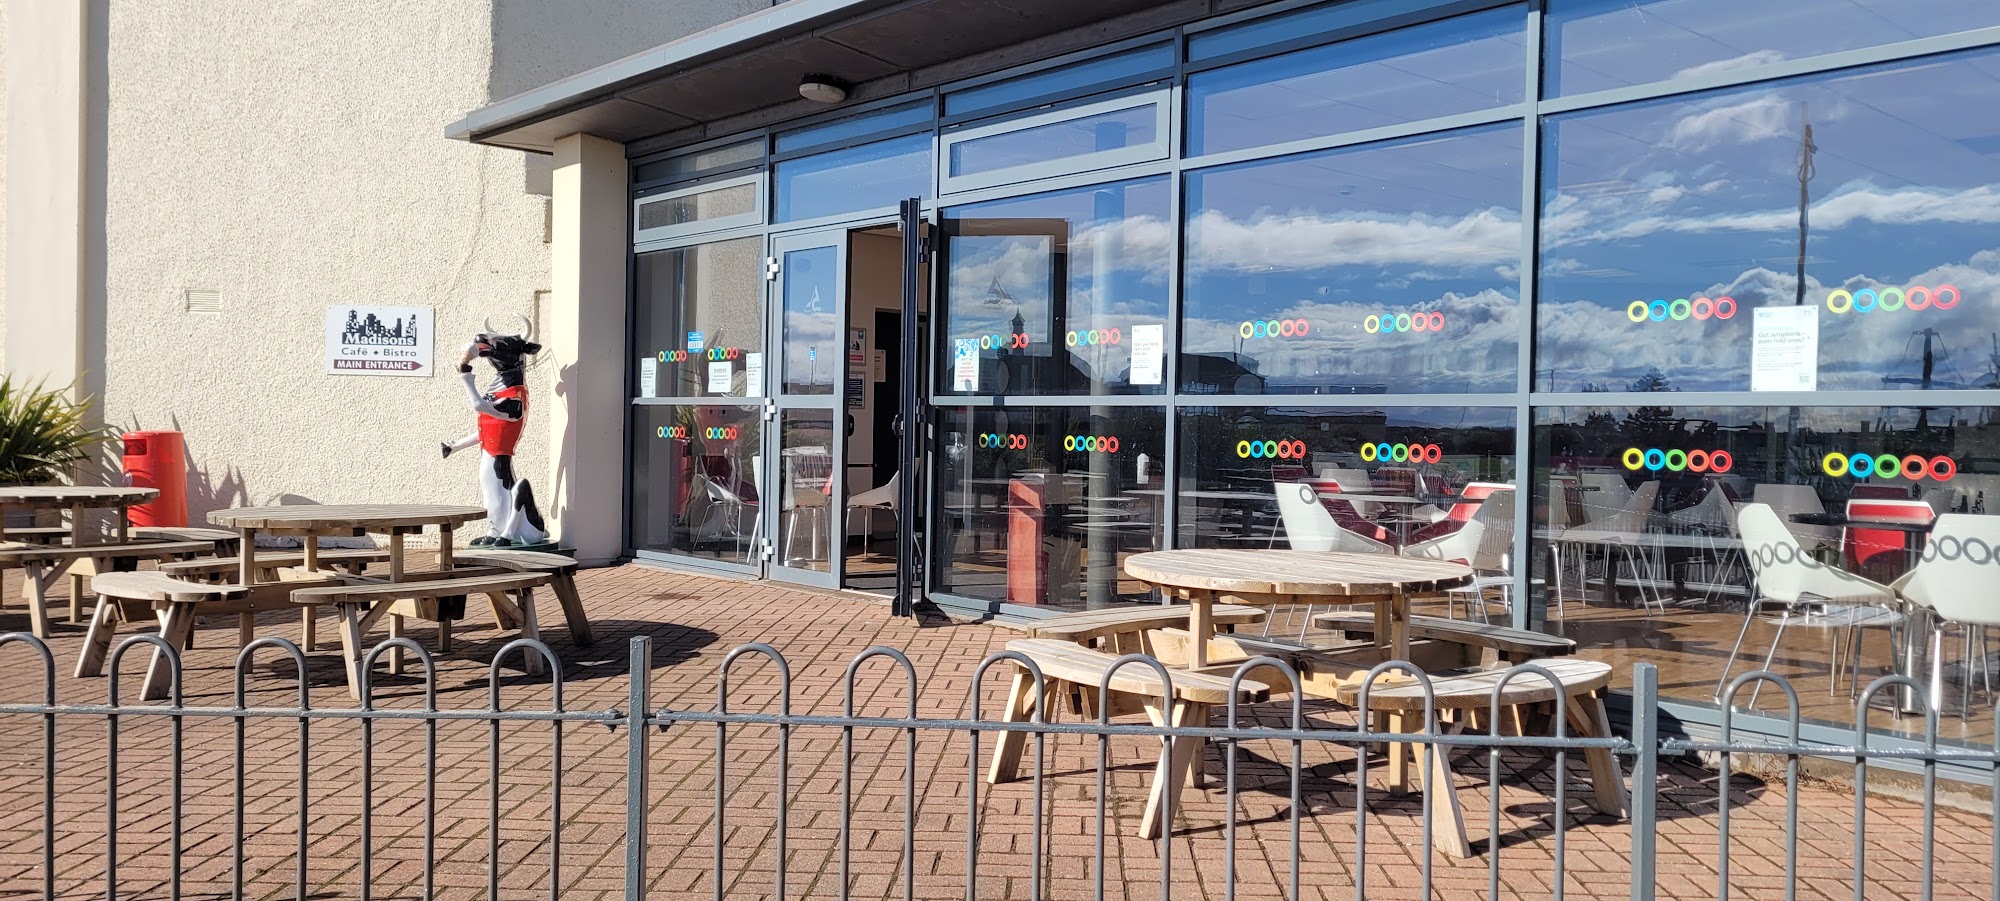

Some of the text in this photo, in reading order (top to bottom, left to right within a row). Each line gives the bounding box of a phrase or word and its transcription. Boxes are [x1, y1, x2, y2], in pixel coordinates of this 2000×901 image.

[344, 333, 415, 346] Madisons
[341, 347, 417, 357] Café Bistro
[336, 360, 413, 370] MAIN ENTRANCE
